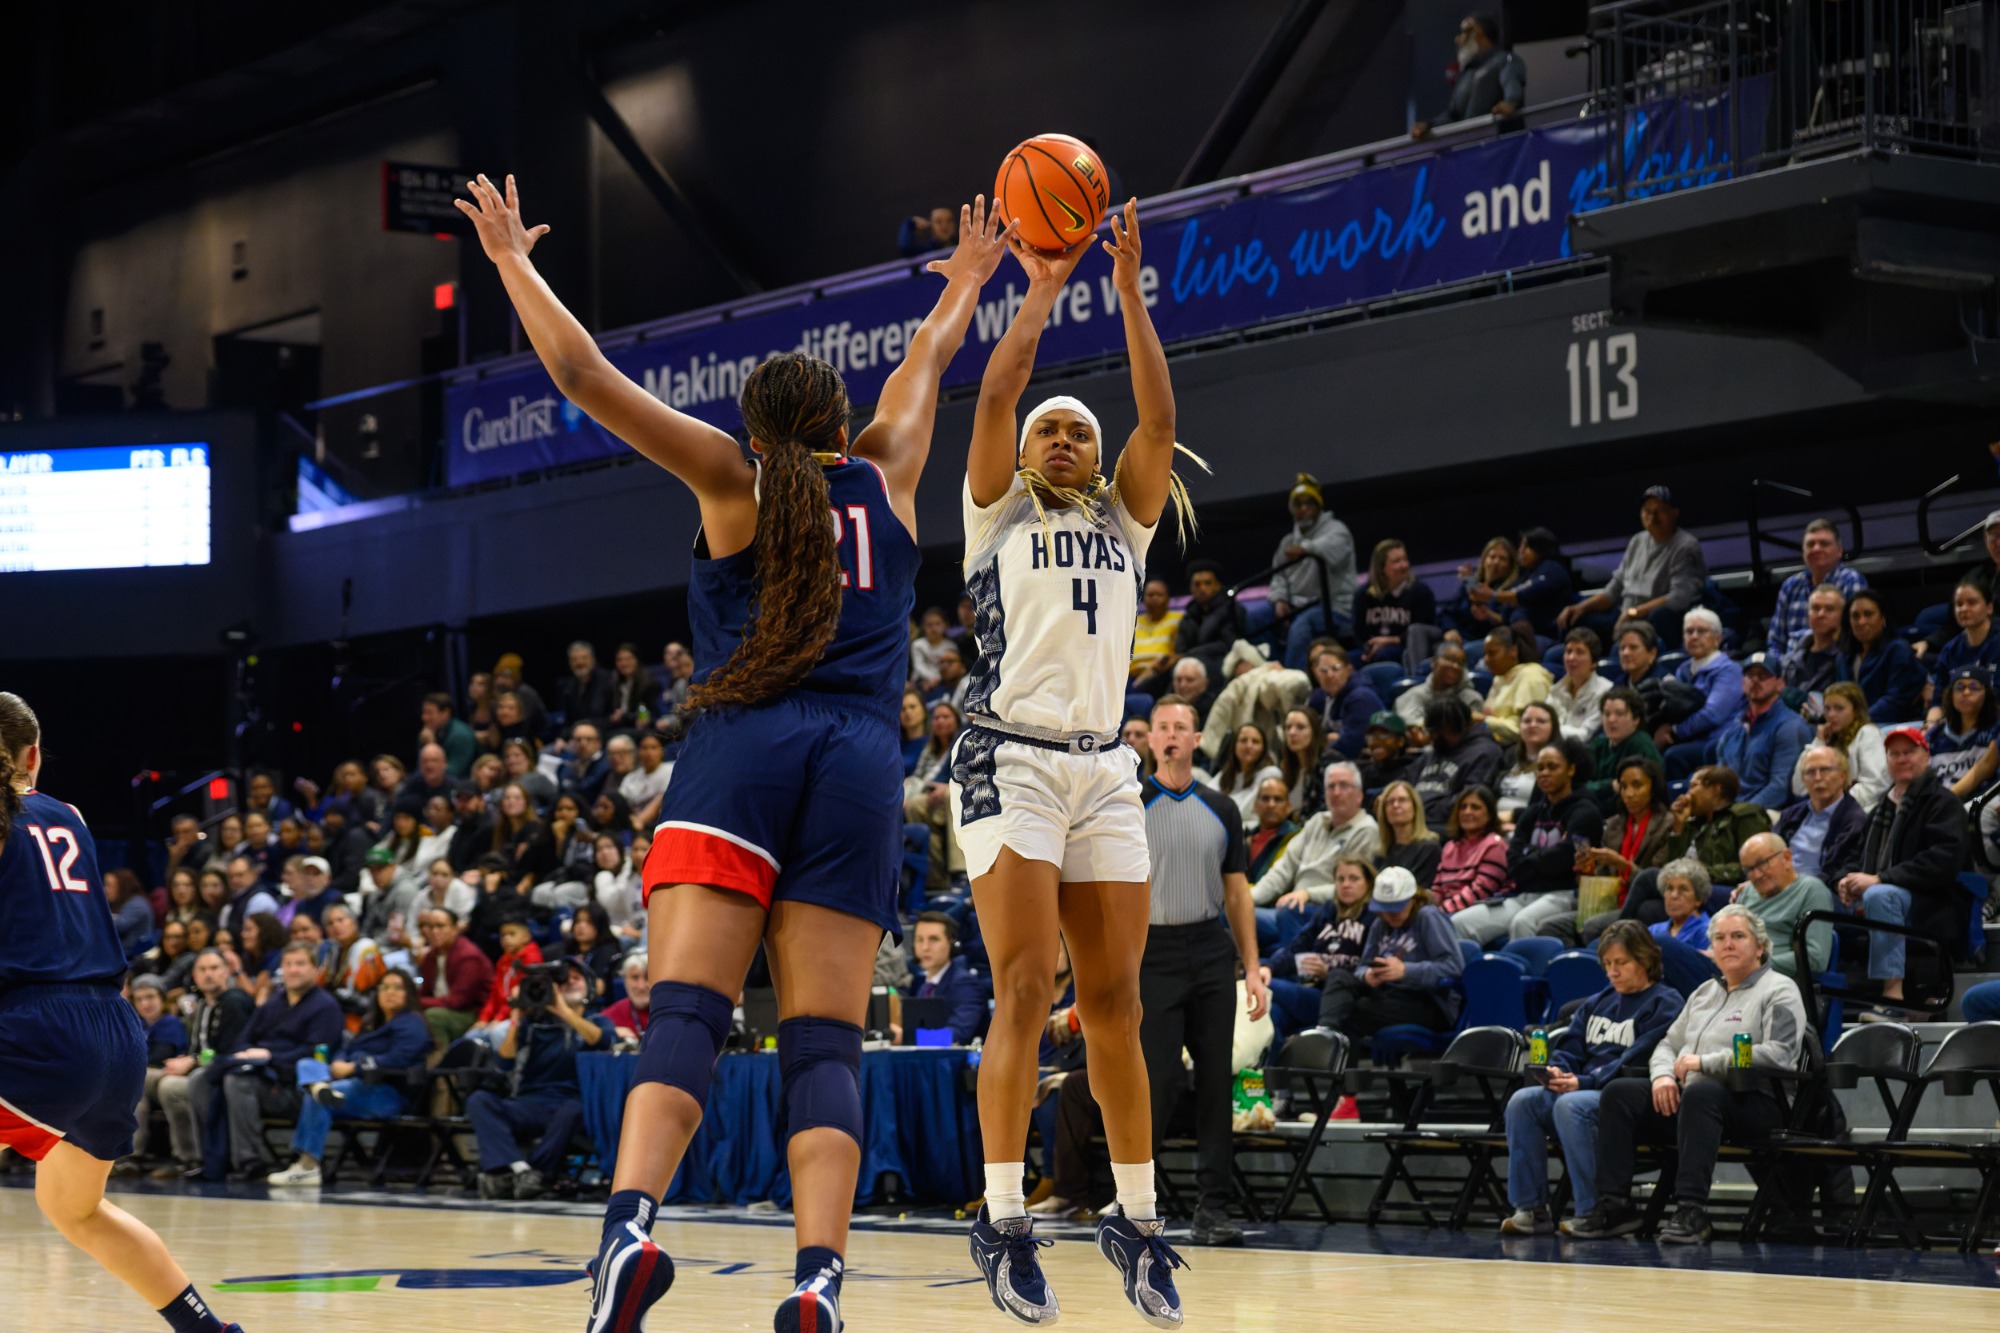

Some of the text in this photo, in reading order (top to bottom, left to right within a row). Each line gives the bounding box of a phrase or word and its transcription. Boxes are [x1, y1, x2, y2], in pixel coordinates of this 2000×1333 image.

[1073, 156, 1107, 214] ELITE
[1170, 217, 1280, 304] live,
[1289, 164, 1447, 277] work
[1461, 159, 1551, 240] and
[1566, 332, 1638, 428] 113
[462, 392, 559, 453] CareFirst
[1031, 530, 1125, 573] HOYAS
[1072, 578, 1098, 635] 4
[1077, 734, 1095, 753] G
[26, 823, 91, 893] 12
